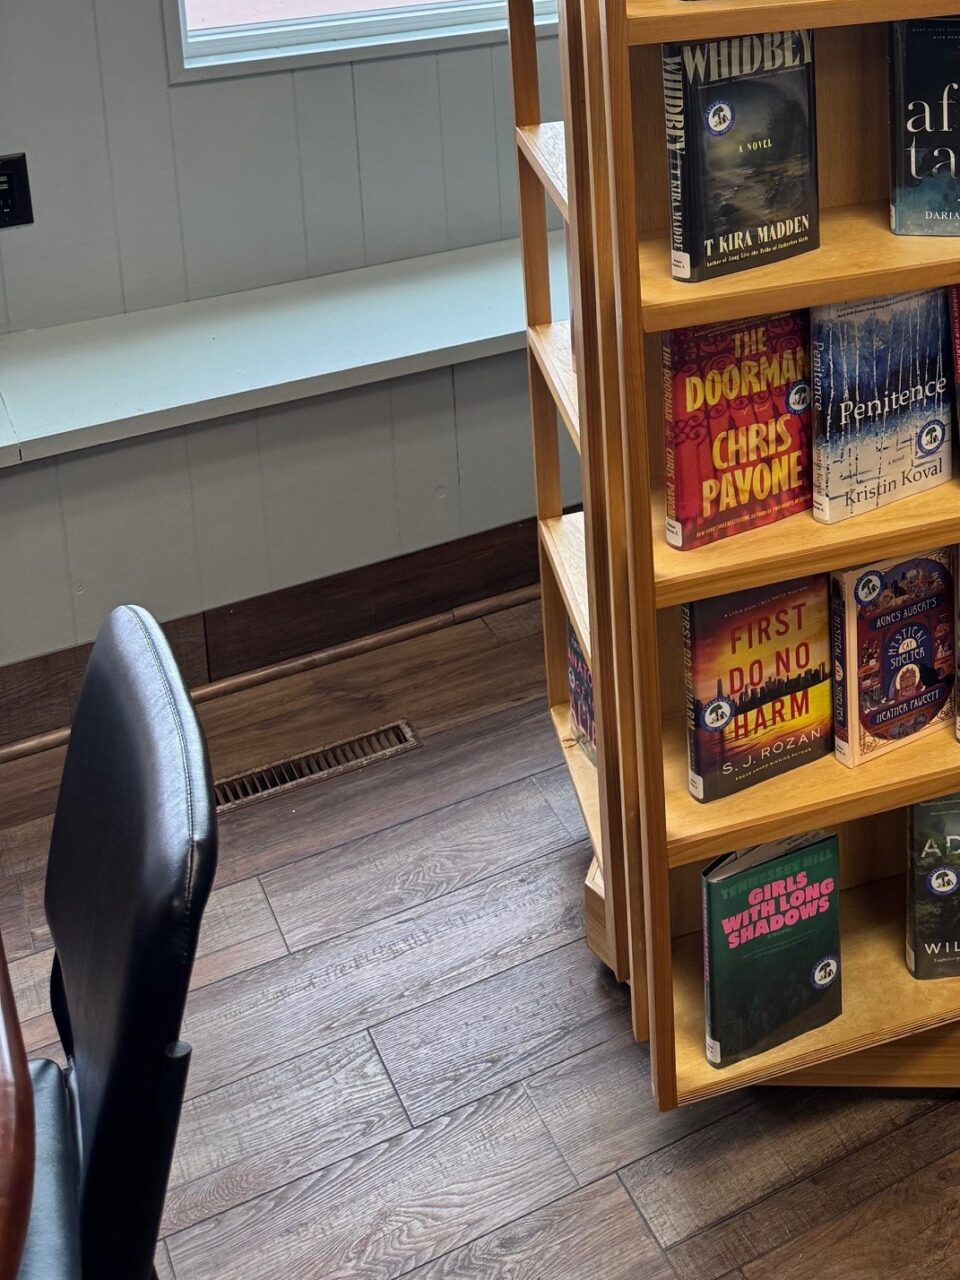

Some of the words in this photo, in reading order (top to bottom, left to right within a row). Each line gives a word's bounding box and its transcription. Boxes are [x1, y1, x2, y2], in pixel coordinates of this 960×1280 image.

[682, 28, 813, 86] WHIDBEY
[663, 55, 685, 155] WHIDBEY
[747, 138, 773, 151] NOVEL
[672, 180, 682, 207] KIRA
[925, 210, 960, 220] DARIA
[672, 211, 683, 251] MADDE
[704, 238, 714, 257] T
[719, 229, 753, 254] KIRA
[757, 214, 809, 244] MADDEN
[760, 246, 772, 254] Tribe
[733, 327, 768, 359] THE
[685, 346, 811, 413] DOORMAN
[839, 376, 947, 426] Penitence
[712, 413, 792, 472] CHRIS
[892, 454, 905, 465] Novel
[702, 450, 803, 519] PAVONE
[844, 477, 898, 508] Kristin
[901, 457, 943, 487] Koval
[730, 602, 807, 655] FIRST
[876, 612, 901, 628] AGNES
[903, 597, 938, 620] AUBERT'S
[888, 623, 927, 656] MYSTICAL
[890, 647, 926, 670] SHELTER
[902, 641, 914, 651] CAT
[681, 606, 691, 644] FIRST
[686, 692, 696, 732] HARM
[729, 659, 763, 696] DO
[775, 641, 811, 677] NO
[733, 689, 810, 743] HARM
[722, 762, 738, 775] S.
[743, 755, 756, 768] J.
[761, 728, 821, 759] ROZAN
[721, 899, 776, 935] WITH
[780, 877, 835, 912] LONG
[748, 871, 808, 906] GIRLS
[728, 895, 830, 949] SHADOWS
